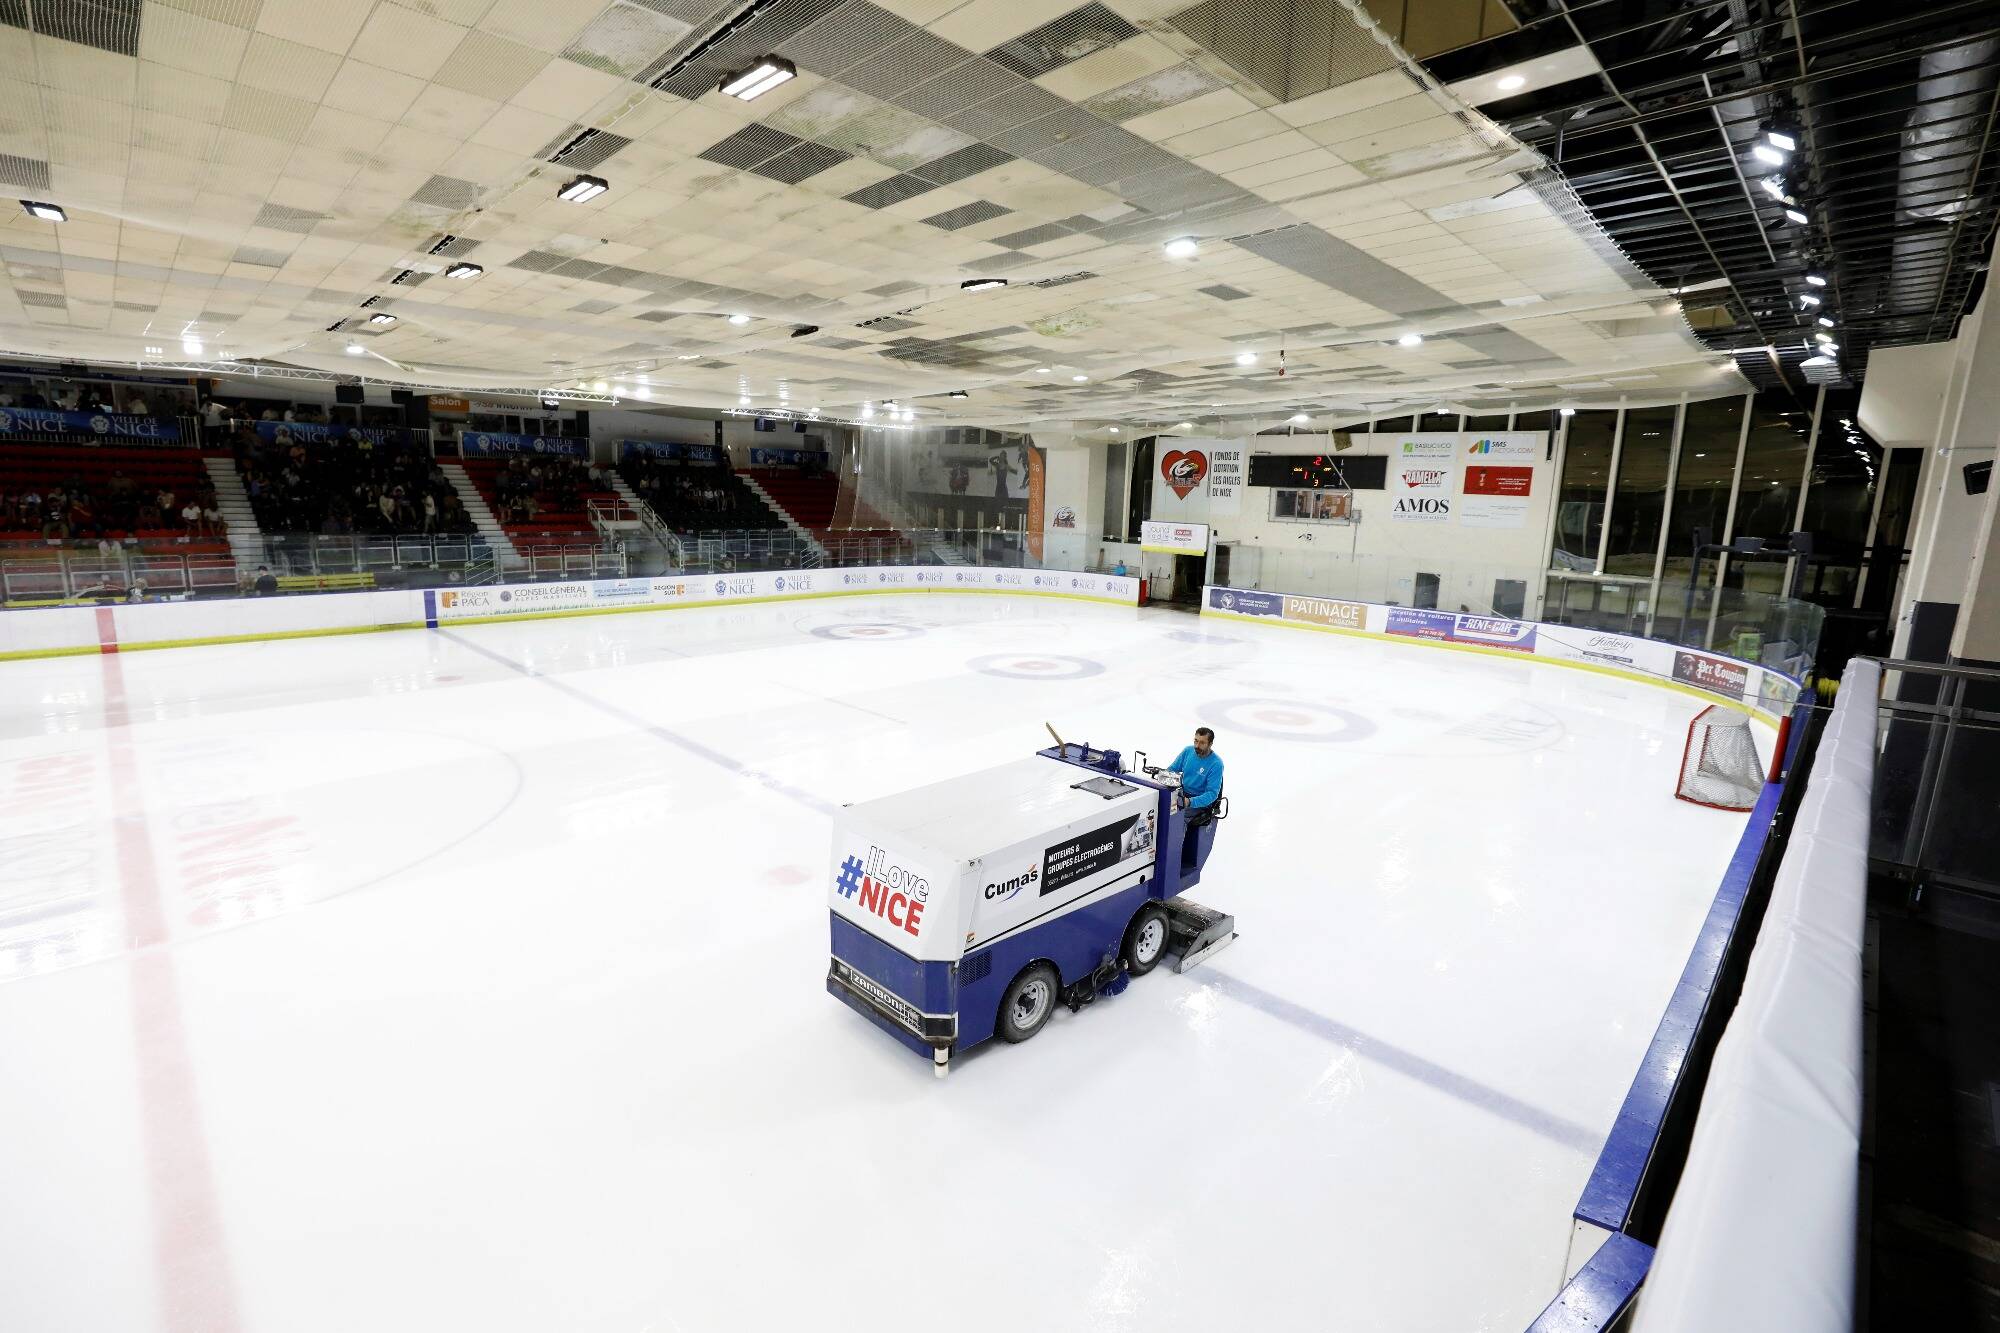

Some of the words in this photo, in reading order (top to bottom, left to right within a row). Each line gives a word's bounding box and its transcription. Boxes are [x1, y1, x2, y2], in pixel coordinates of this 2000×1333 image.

[430, 396, 461, 407] Salon
[17, 418, 69, 434] NICE
[114, 422, 160, 437] NICE
[491, 440, 521, 452] NICE
[547, 443, 576, 454] NICE
[1214, 451, 1232, 461] FONDS
[1233, 451, 1240, 461] DE
[1213, 464, 1239, 473] DOTATION
[1212, 476, 1222, 485] LES
[1223, 476, 1241, 486] AIGLES
[1405, 470, 1442, 485] RAMELLA
[1393, 498, 1450, 514] AMOS
[729, 584, 756, 595] NICE
[788, 580, 813, 590] NICE
[514, 588, 549, 598] CONSEIL
[461, 597, 491, 607] PACA
[1290, 599, 1360, 620] PATINAGE
[1389, 609, 1417, 617] Location
[1427, 613, 1454, 621] voitures
[1328, 618, 1359, 627] MAGAZINE
[1465, 618, 1489, 631] RENT
[1492, 621, 1512, 634] CAR
[1048, 845, 1075, 864] MOTEURS
[1075, 843, 1080, 853] &
[1047, 857, 1074, 875] GROUPES
[984, 870, 1038, 900] Cumas
[858, 876, 925, 937] NICE
